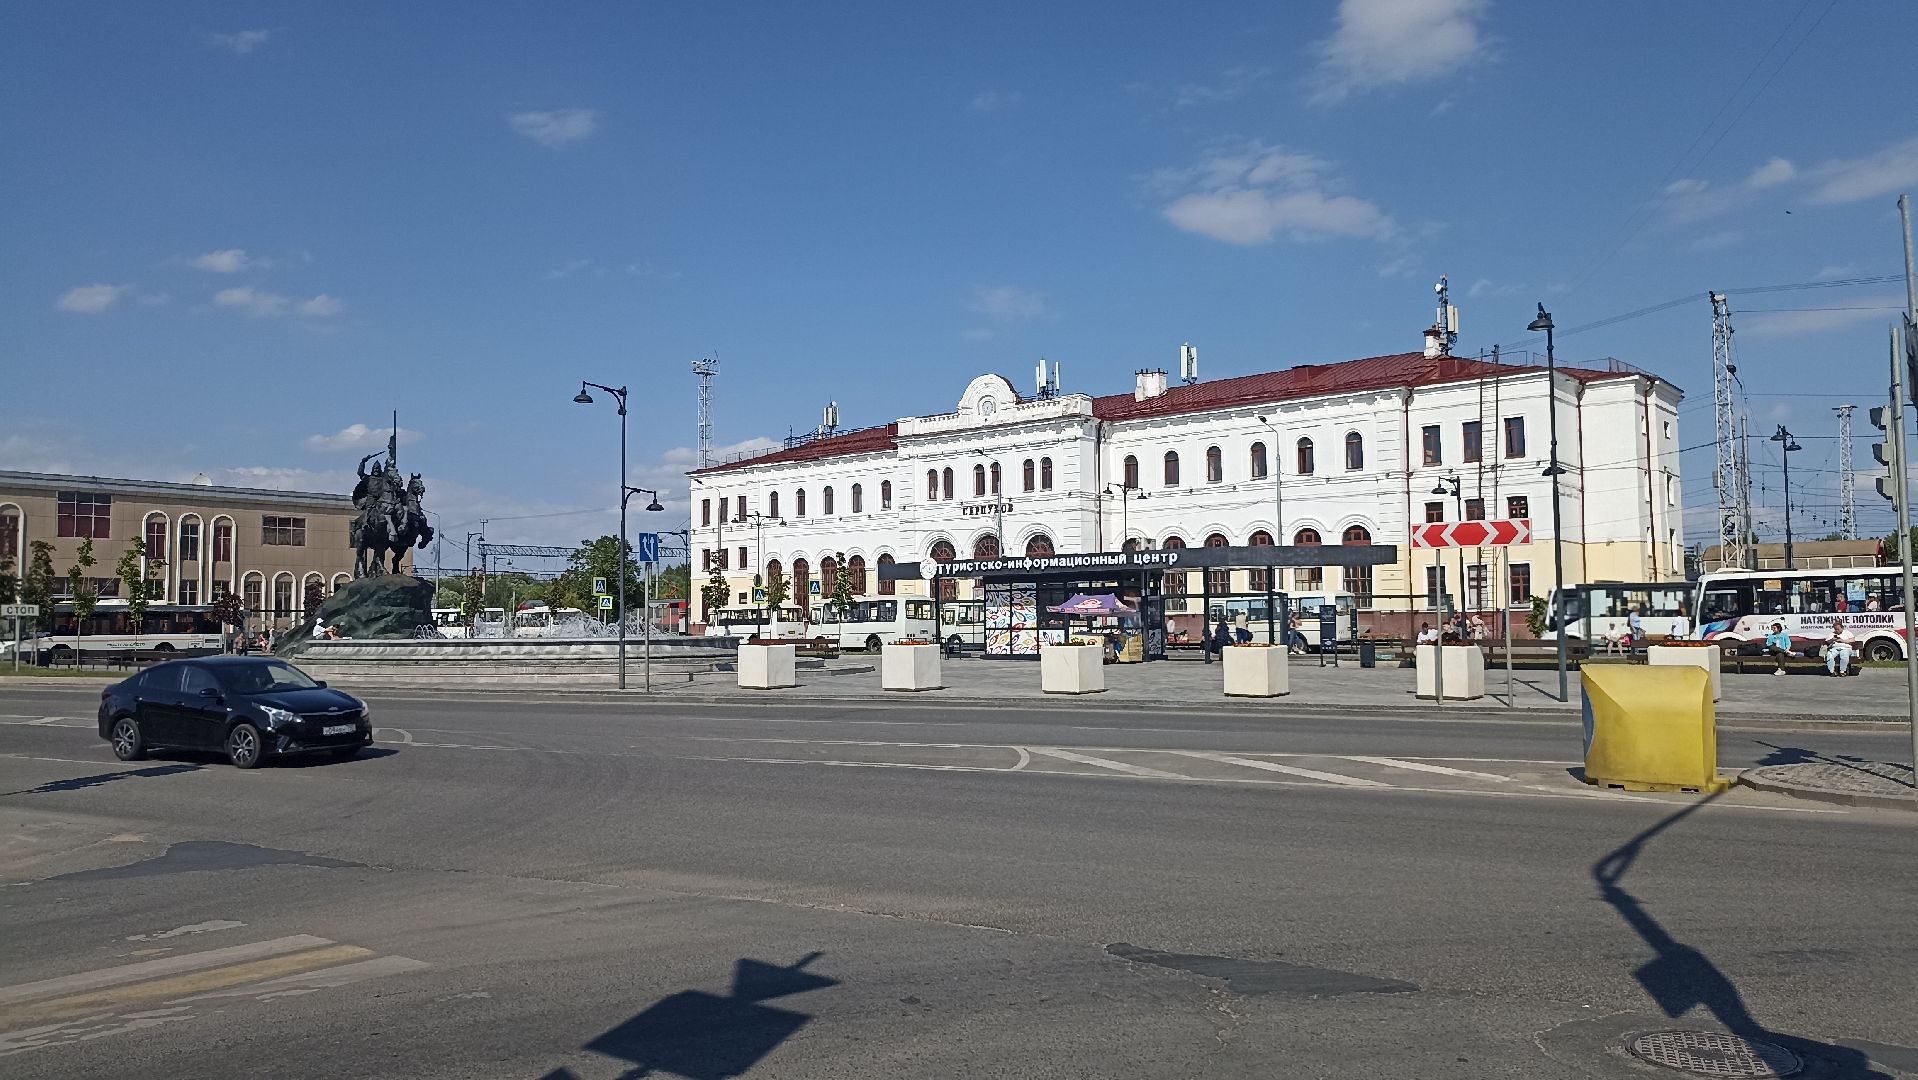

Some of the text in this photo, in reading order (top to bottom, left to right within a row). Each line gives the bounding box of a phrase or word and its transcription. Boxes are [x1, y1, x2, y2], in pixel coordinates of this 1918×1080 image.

[962, 504, 1014, 516] СЕРПУХОВ
[1133, 552, 1178, 566] центр
[6, 606, 35, 615] СТОП
[1852, 614, 1895, 624] ПОТОЛКИ
